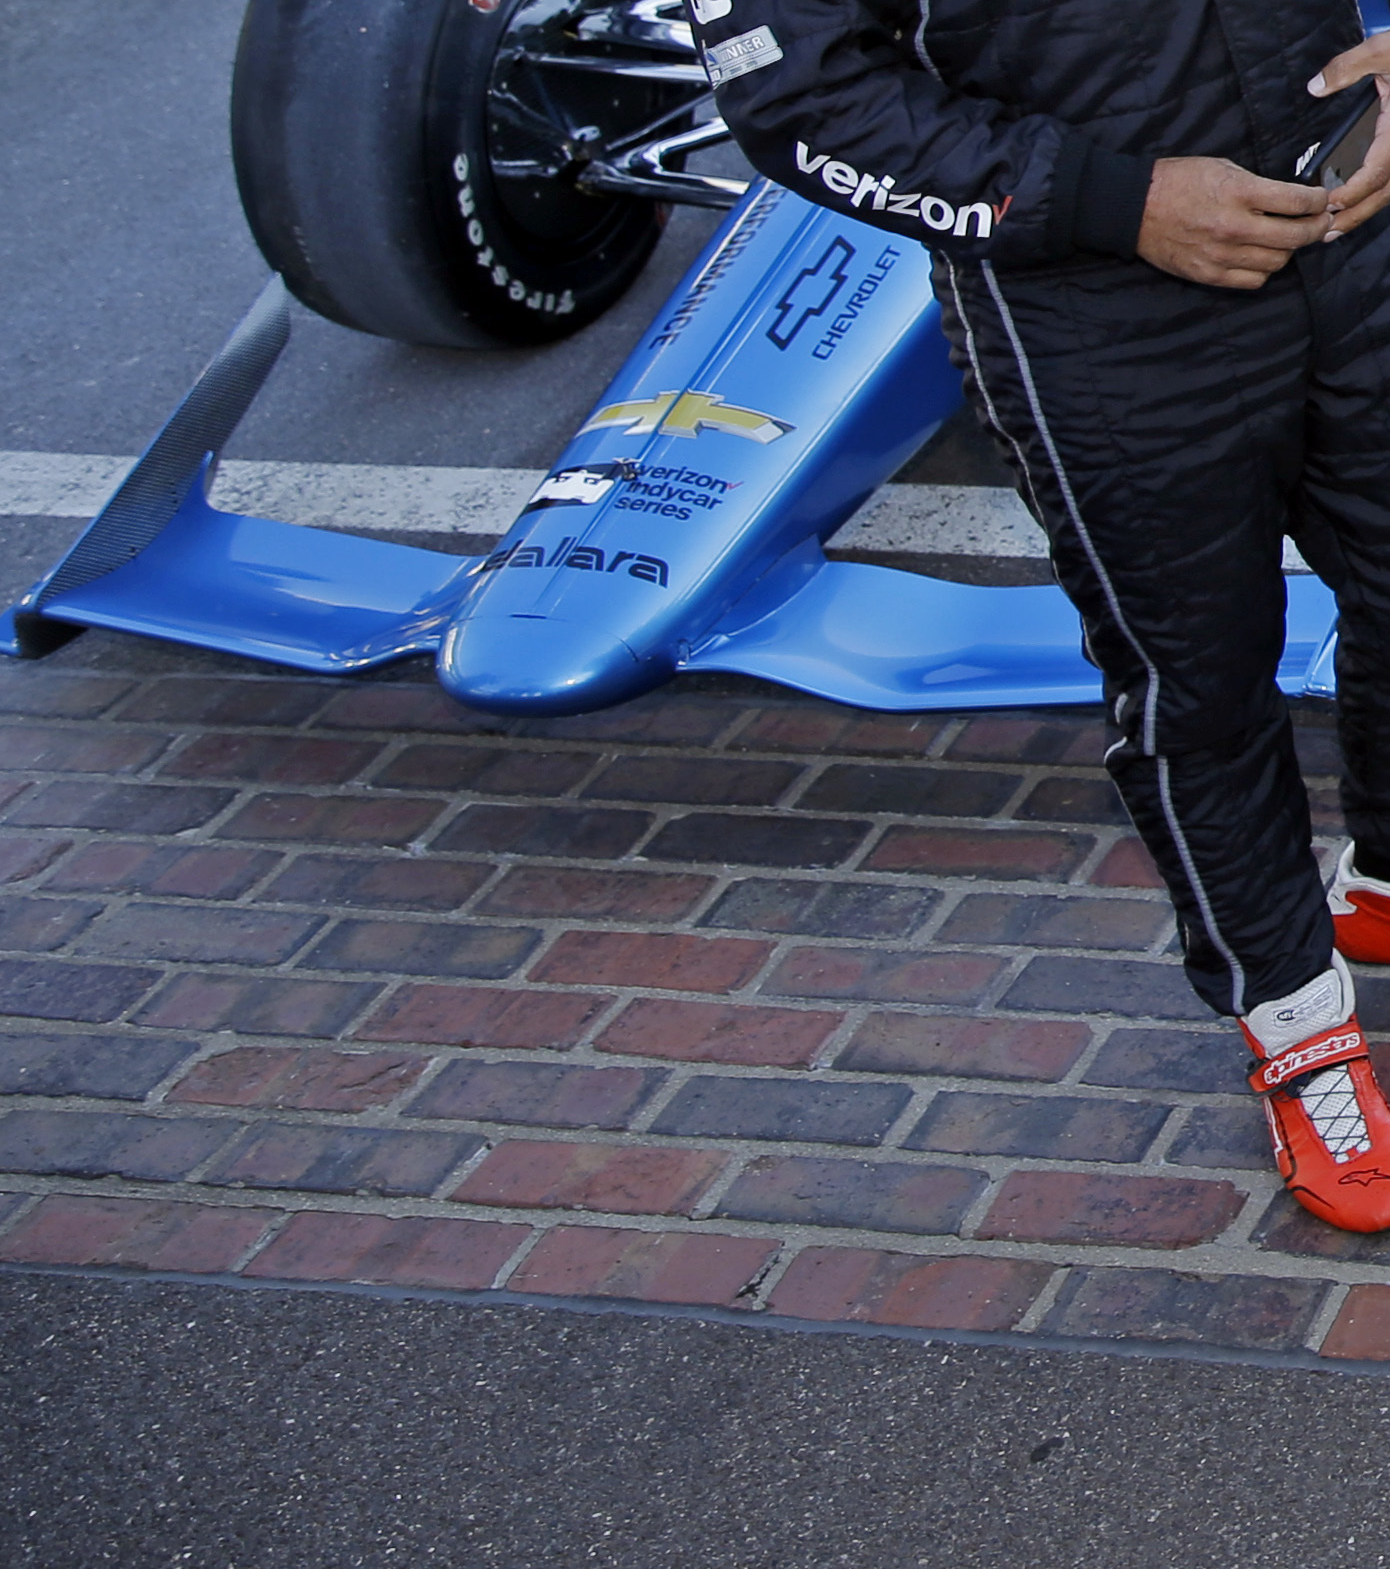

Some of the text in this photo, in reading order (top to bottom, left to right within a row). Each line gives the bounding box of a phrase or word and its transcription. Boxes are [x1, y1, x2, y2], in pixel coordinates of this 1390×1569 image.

[795, 140, 993, 238] verizon
[453, 153, 575, 316] Firestone
[811, 244, 901, 361] CHEVROLET
[626, 481, 723, 511] indycar
[635, 464, 729, 494] verizon
[614, 493, 693, 521] series
[481, 536, 670, 589] dallara
